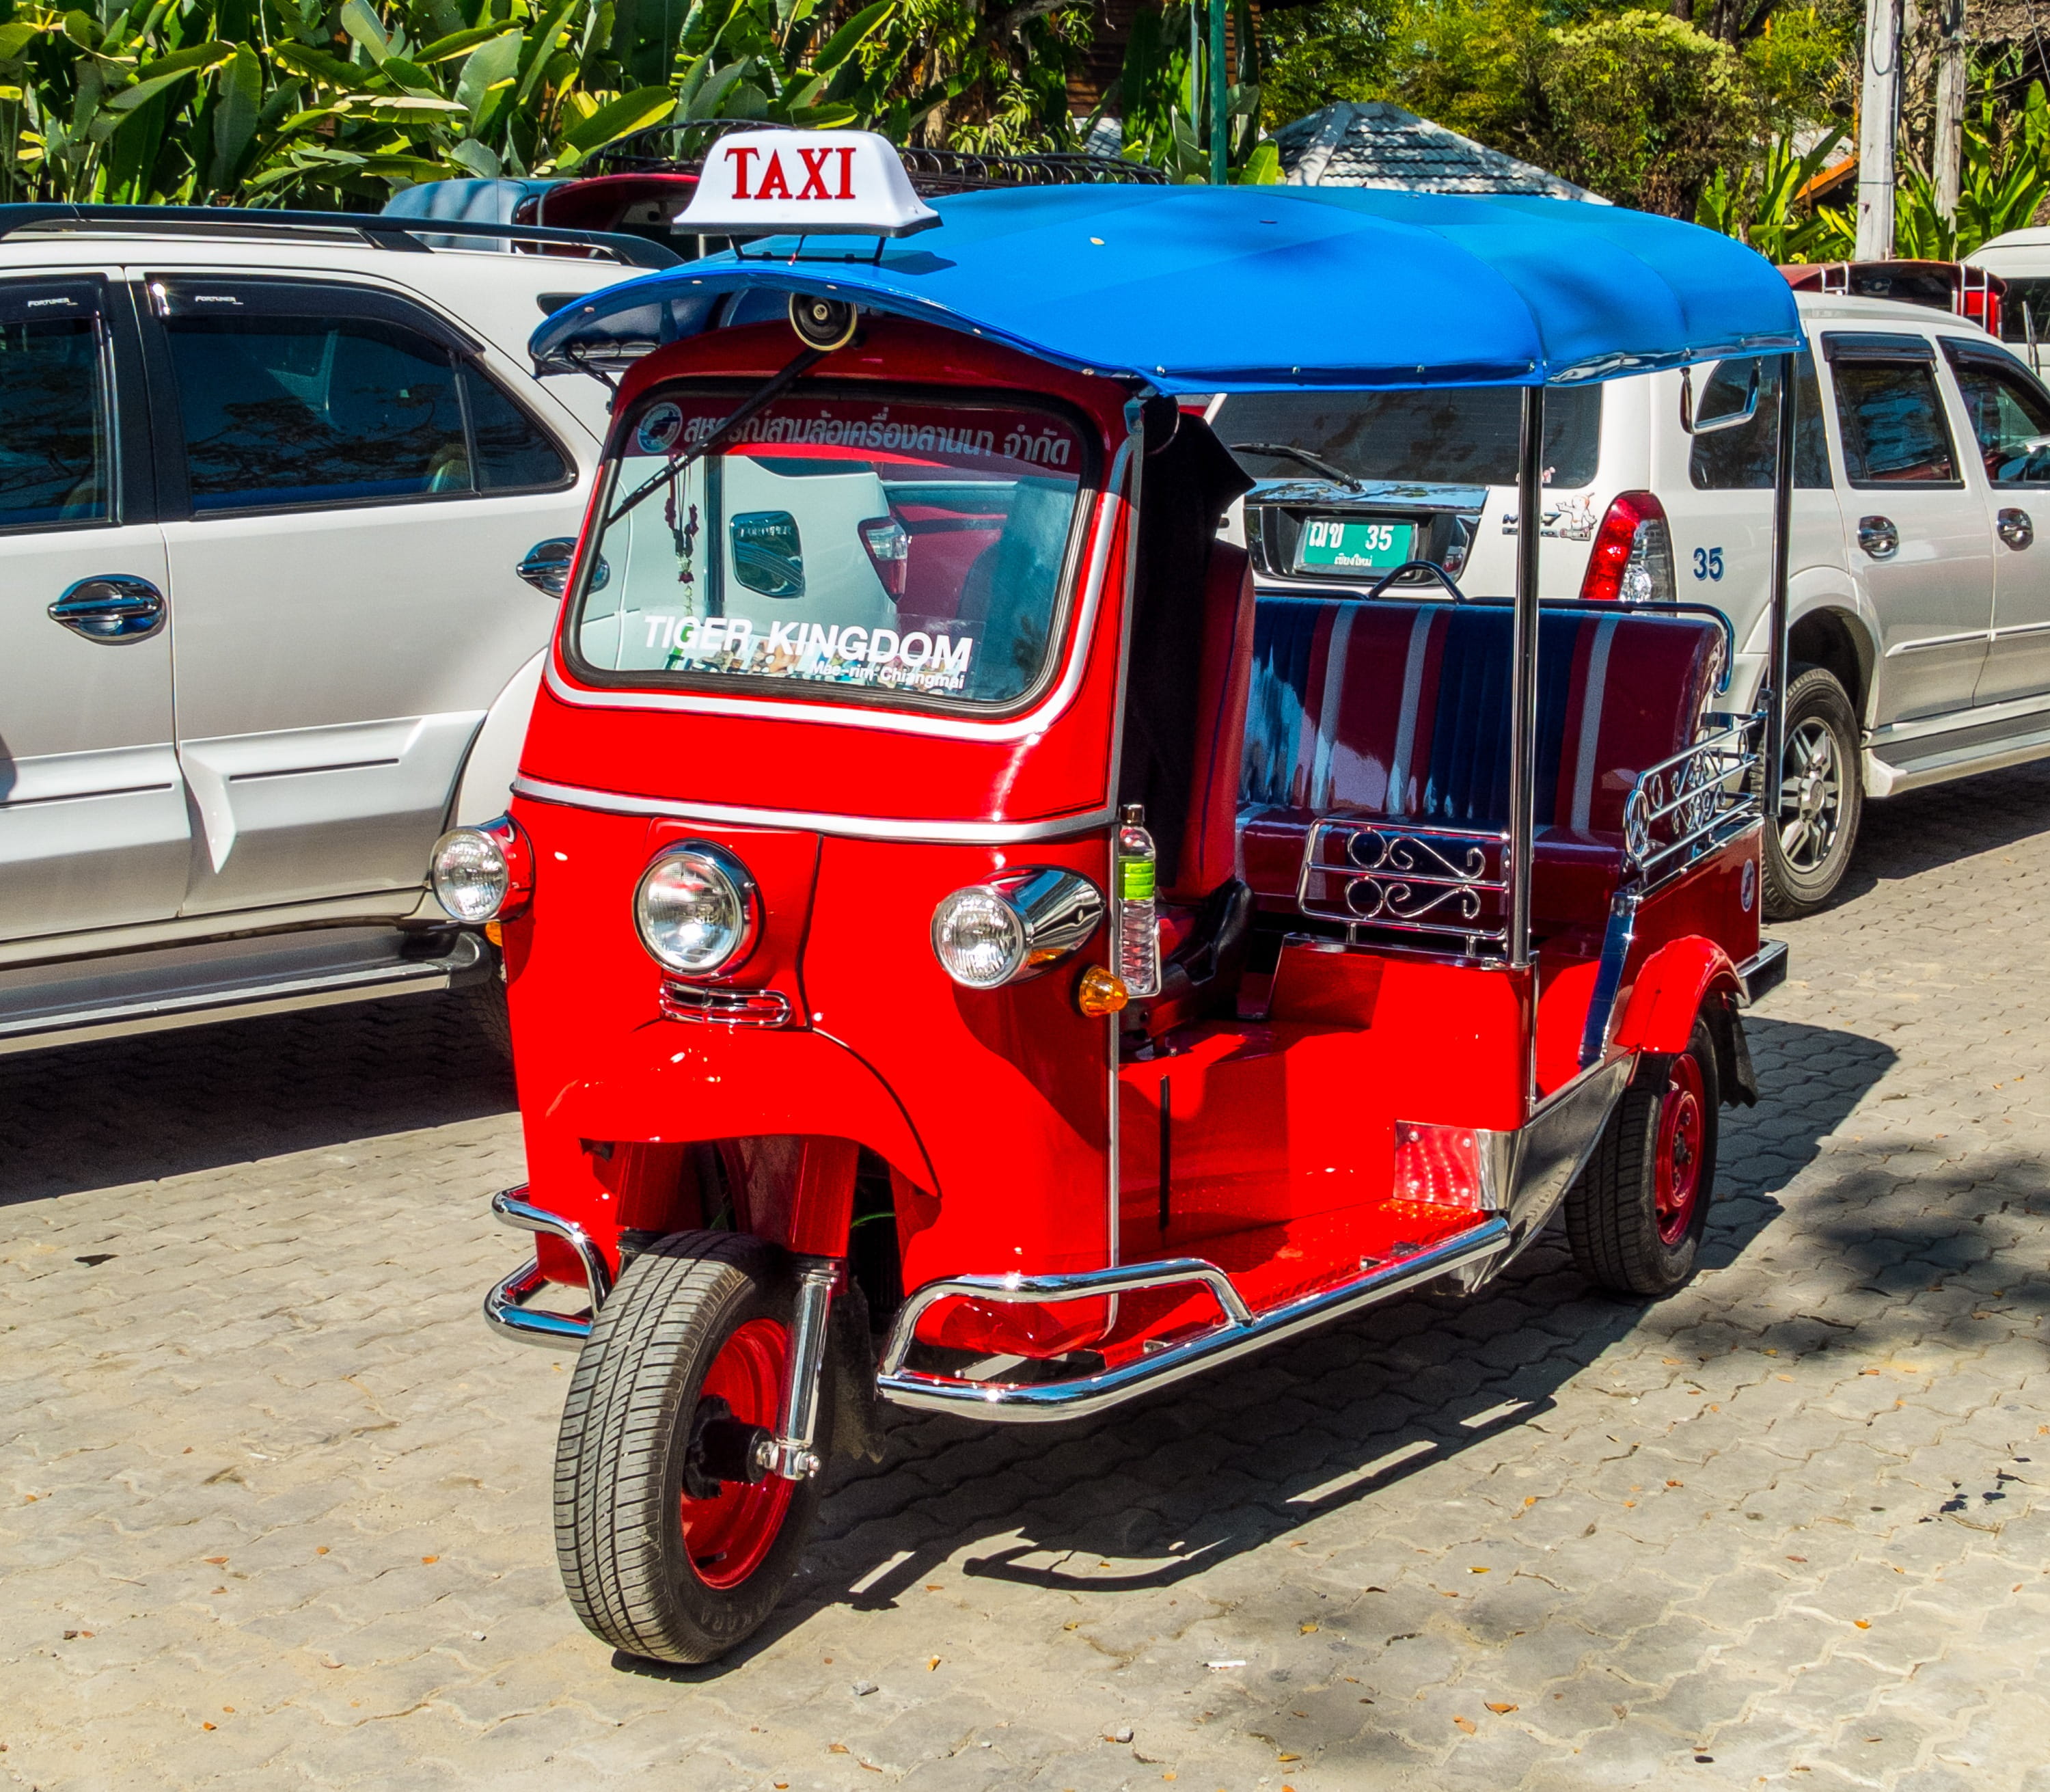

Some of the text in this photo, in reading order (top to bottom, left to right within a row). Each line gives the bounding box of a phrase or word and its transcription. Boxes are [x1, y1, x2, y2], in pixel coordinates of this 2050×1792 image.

[724, 147, 856, 200] TAXI
[1365, 525, 1395, 551] 35
[1693, 547, 1724, 582] 35
[644, 615, 973, 673] TIGER KINGDOM
[879, 666, 965, 690] Chiangmai
